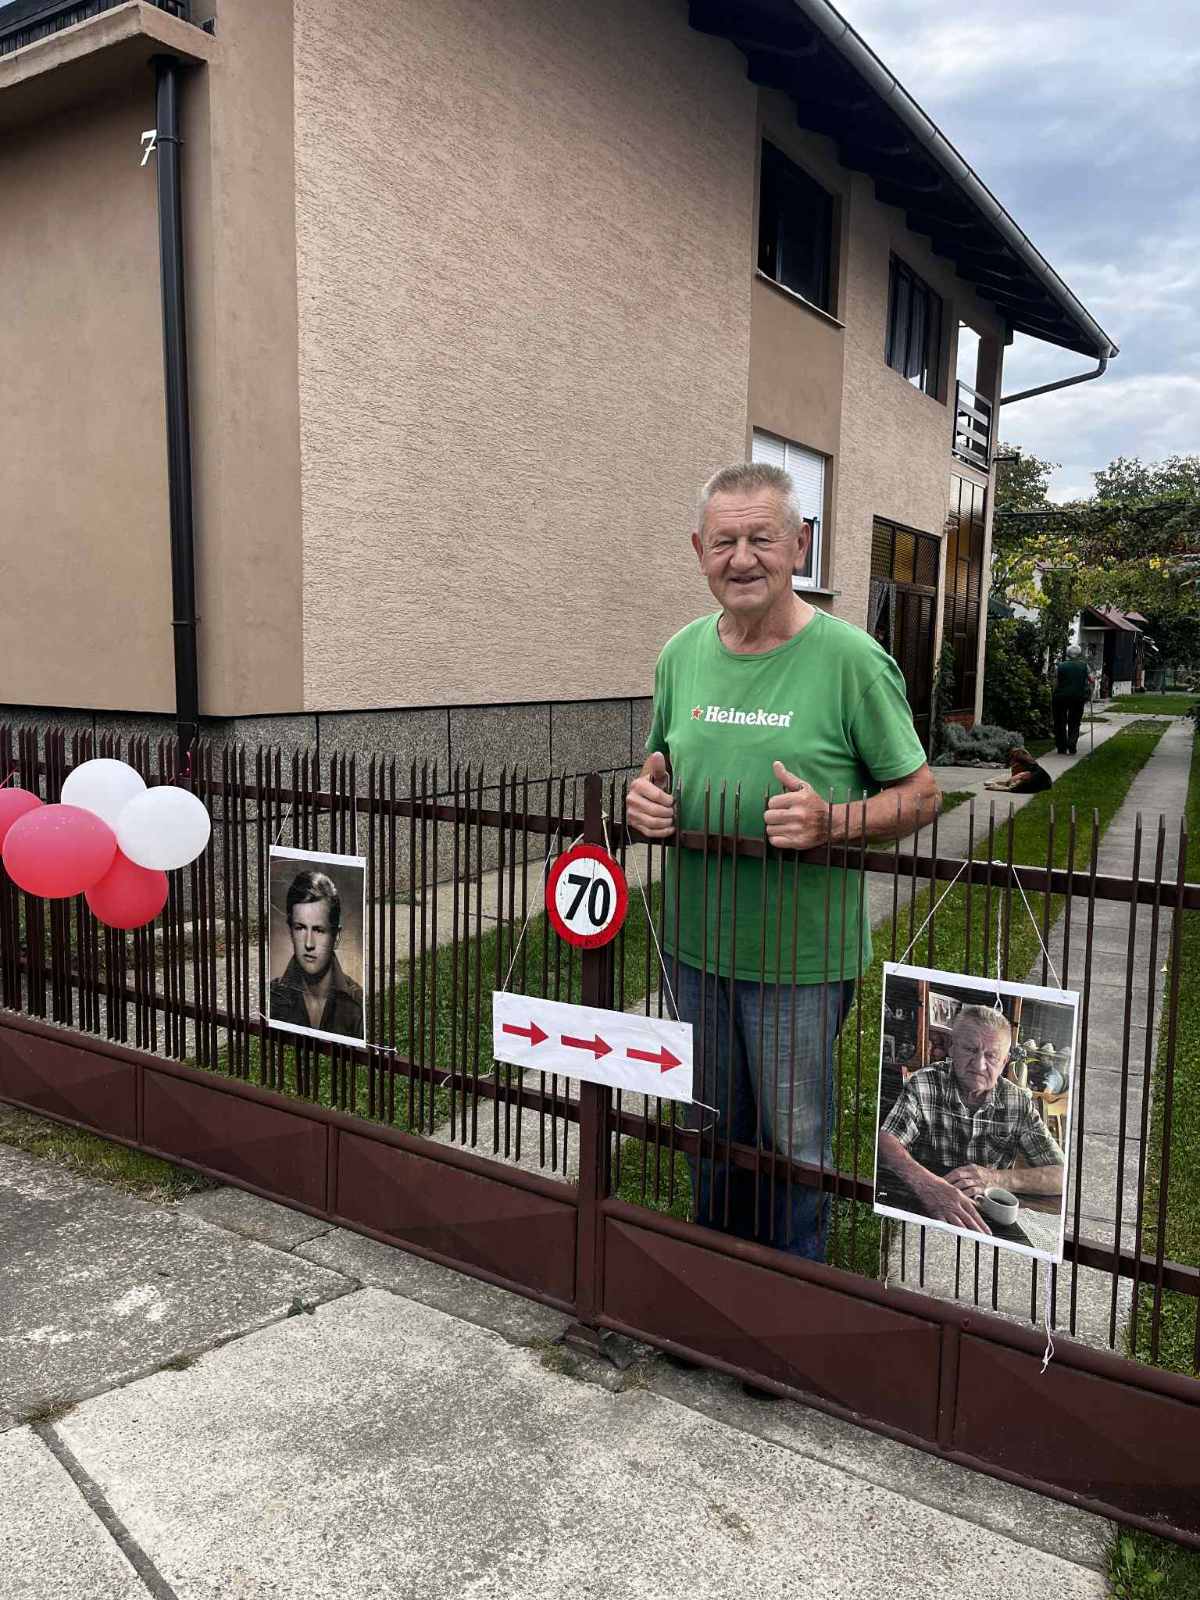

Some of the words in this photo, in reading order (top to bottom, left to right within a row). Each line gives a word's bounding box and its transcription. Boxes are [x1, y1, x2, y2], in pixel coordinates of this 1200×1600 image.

[140, 129, 157, 166] 7
[704, 705, 791, 728] Heineken
[565, 873, 611, 927] 70
